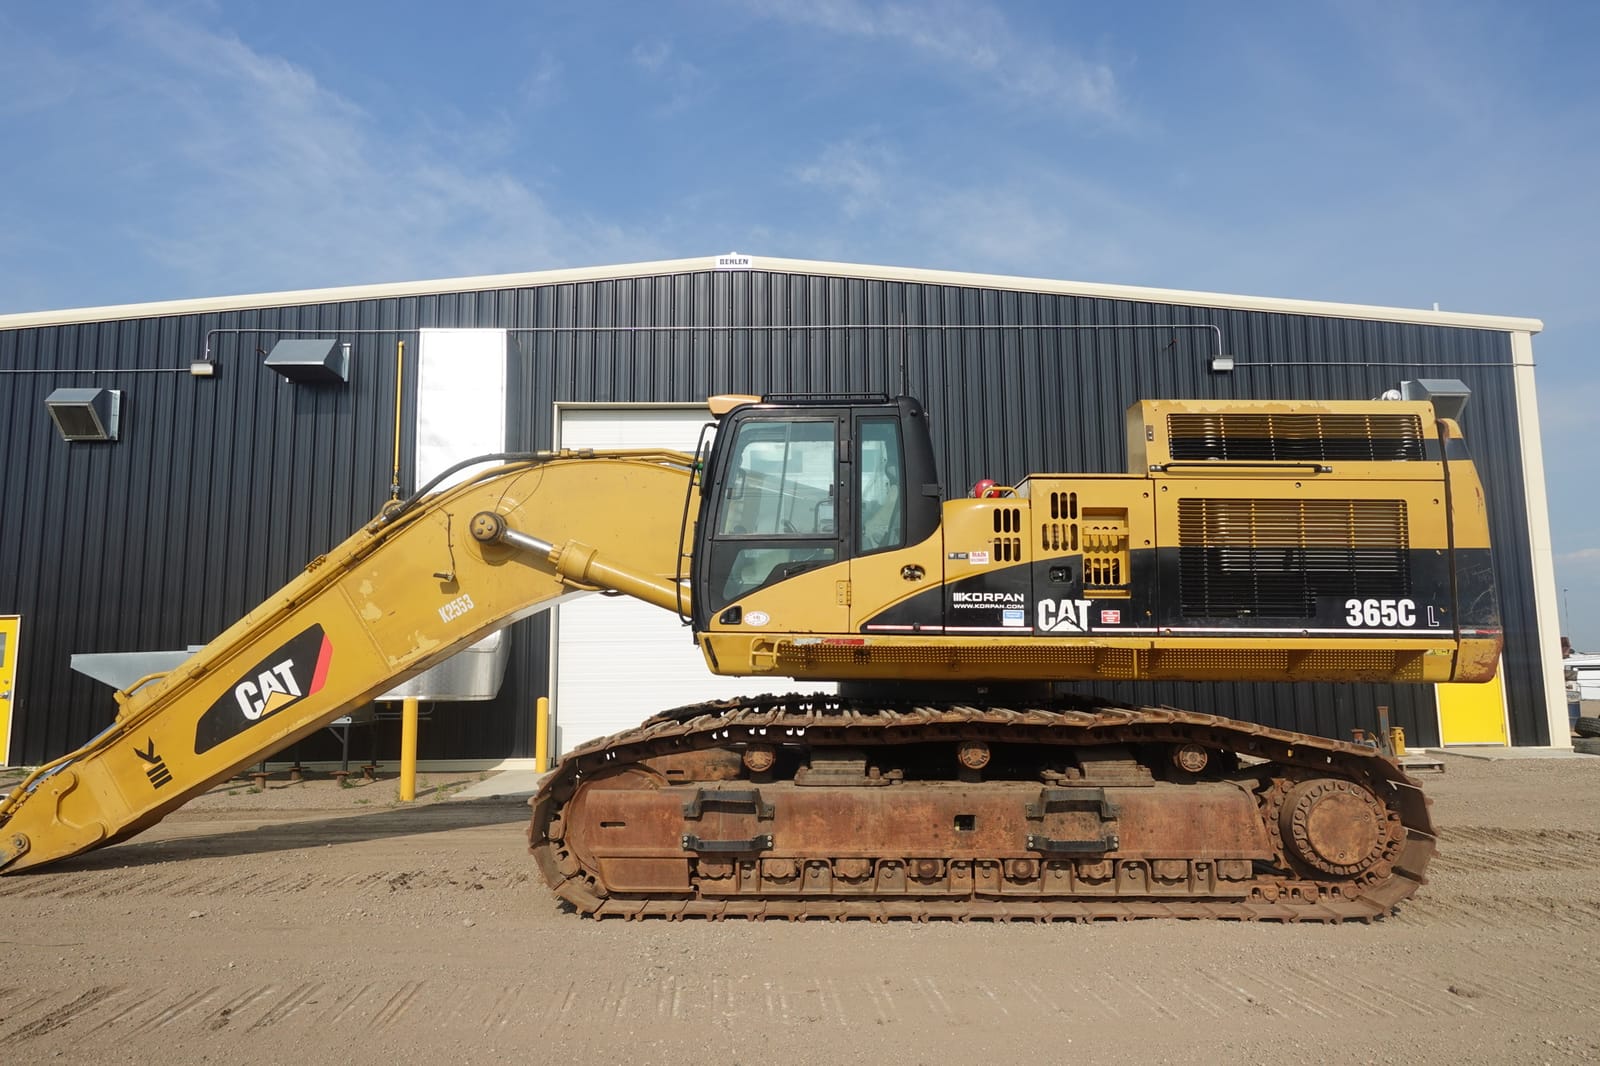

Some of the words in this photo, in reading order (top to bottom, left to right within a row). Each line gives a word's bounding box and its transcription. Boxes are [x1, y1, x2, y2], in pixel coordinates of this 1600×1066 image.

[438, 593, 475, 623] K2553
[1037, 598, 1092, 632] CAT
[1345, 598, 1416, 627] 365C
[1427, 605, 1440, 627] L
[235, 659, 301, 720] CAT
